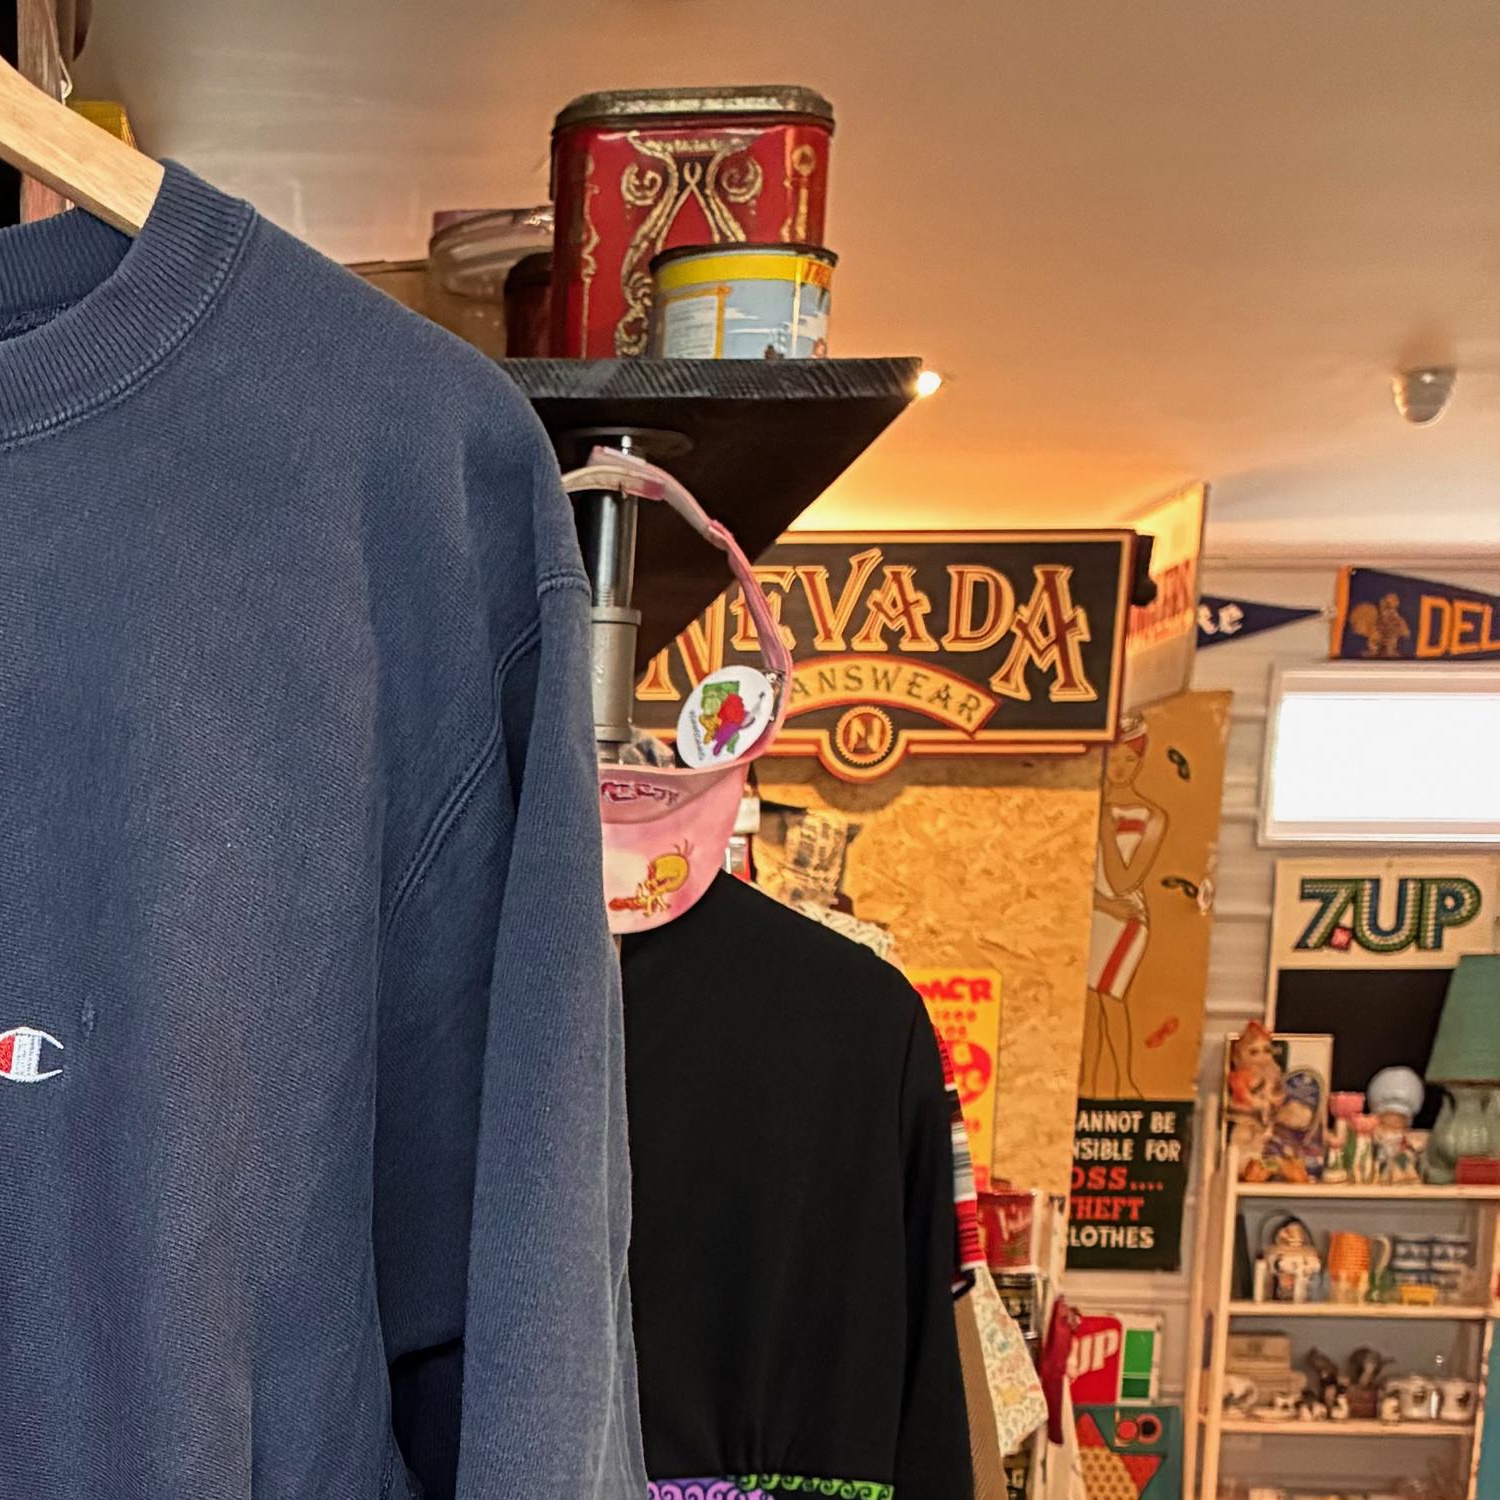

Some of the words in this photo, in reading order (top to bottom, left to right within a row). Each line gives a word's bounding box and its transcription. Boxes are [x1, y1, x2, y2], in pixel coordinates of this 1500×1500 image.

[636, 548, 1098, 702] NEVADA
[792, 664, 982, 724] ANSWEAR
[1295, 877, 1482, 953] 7UP
[1077, 1111, 1143, 1133] ANNOT
[1151, 1111, 1176, 1133] BE
[1074, 1138, 1134, 1160] NSIBLE
[1145, 1140, 1181, 1161] FOR
[1068, 1226, 1154, 1248] LOTHES
